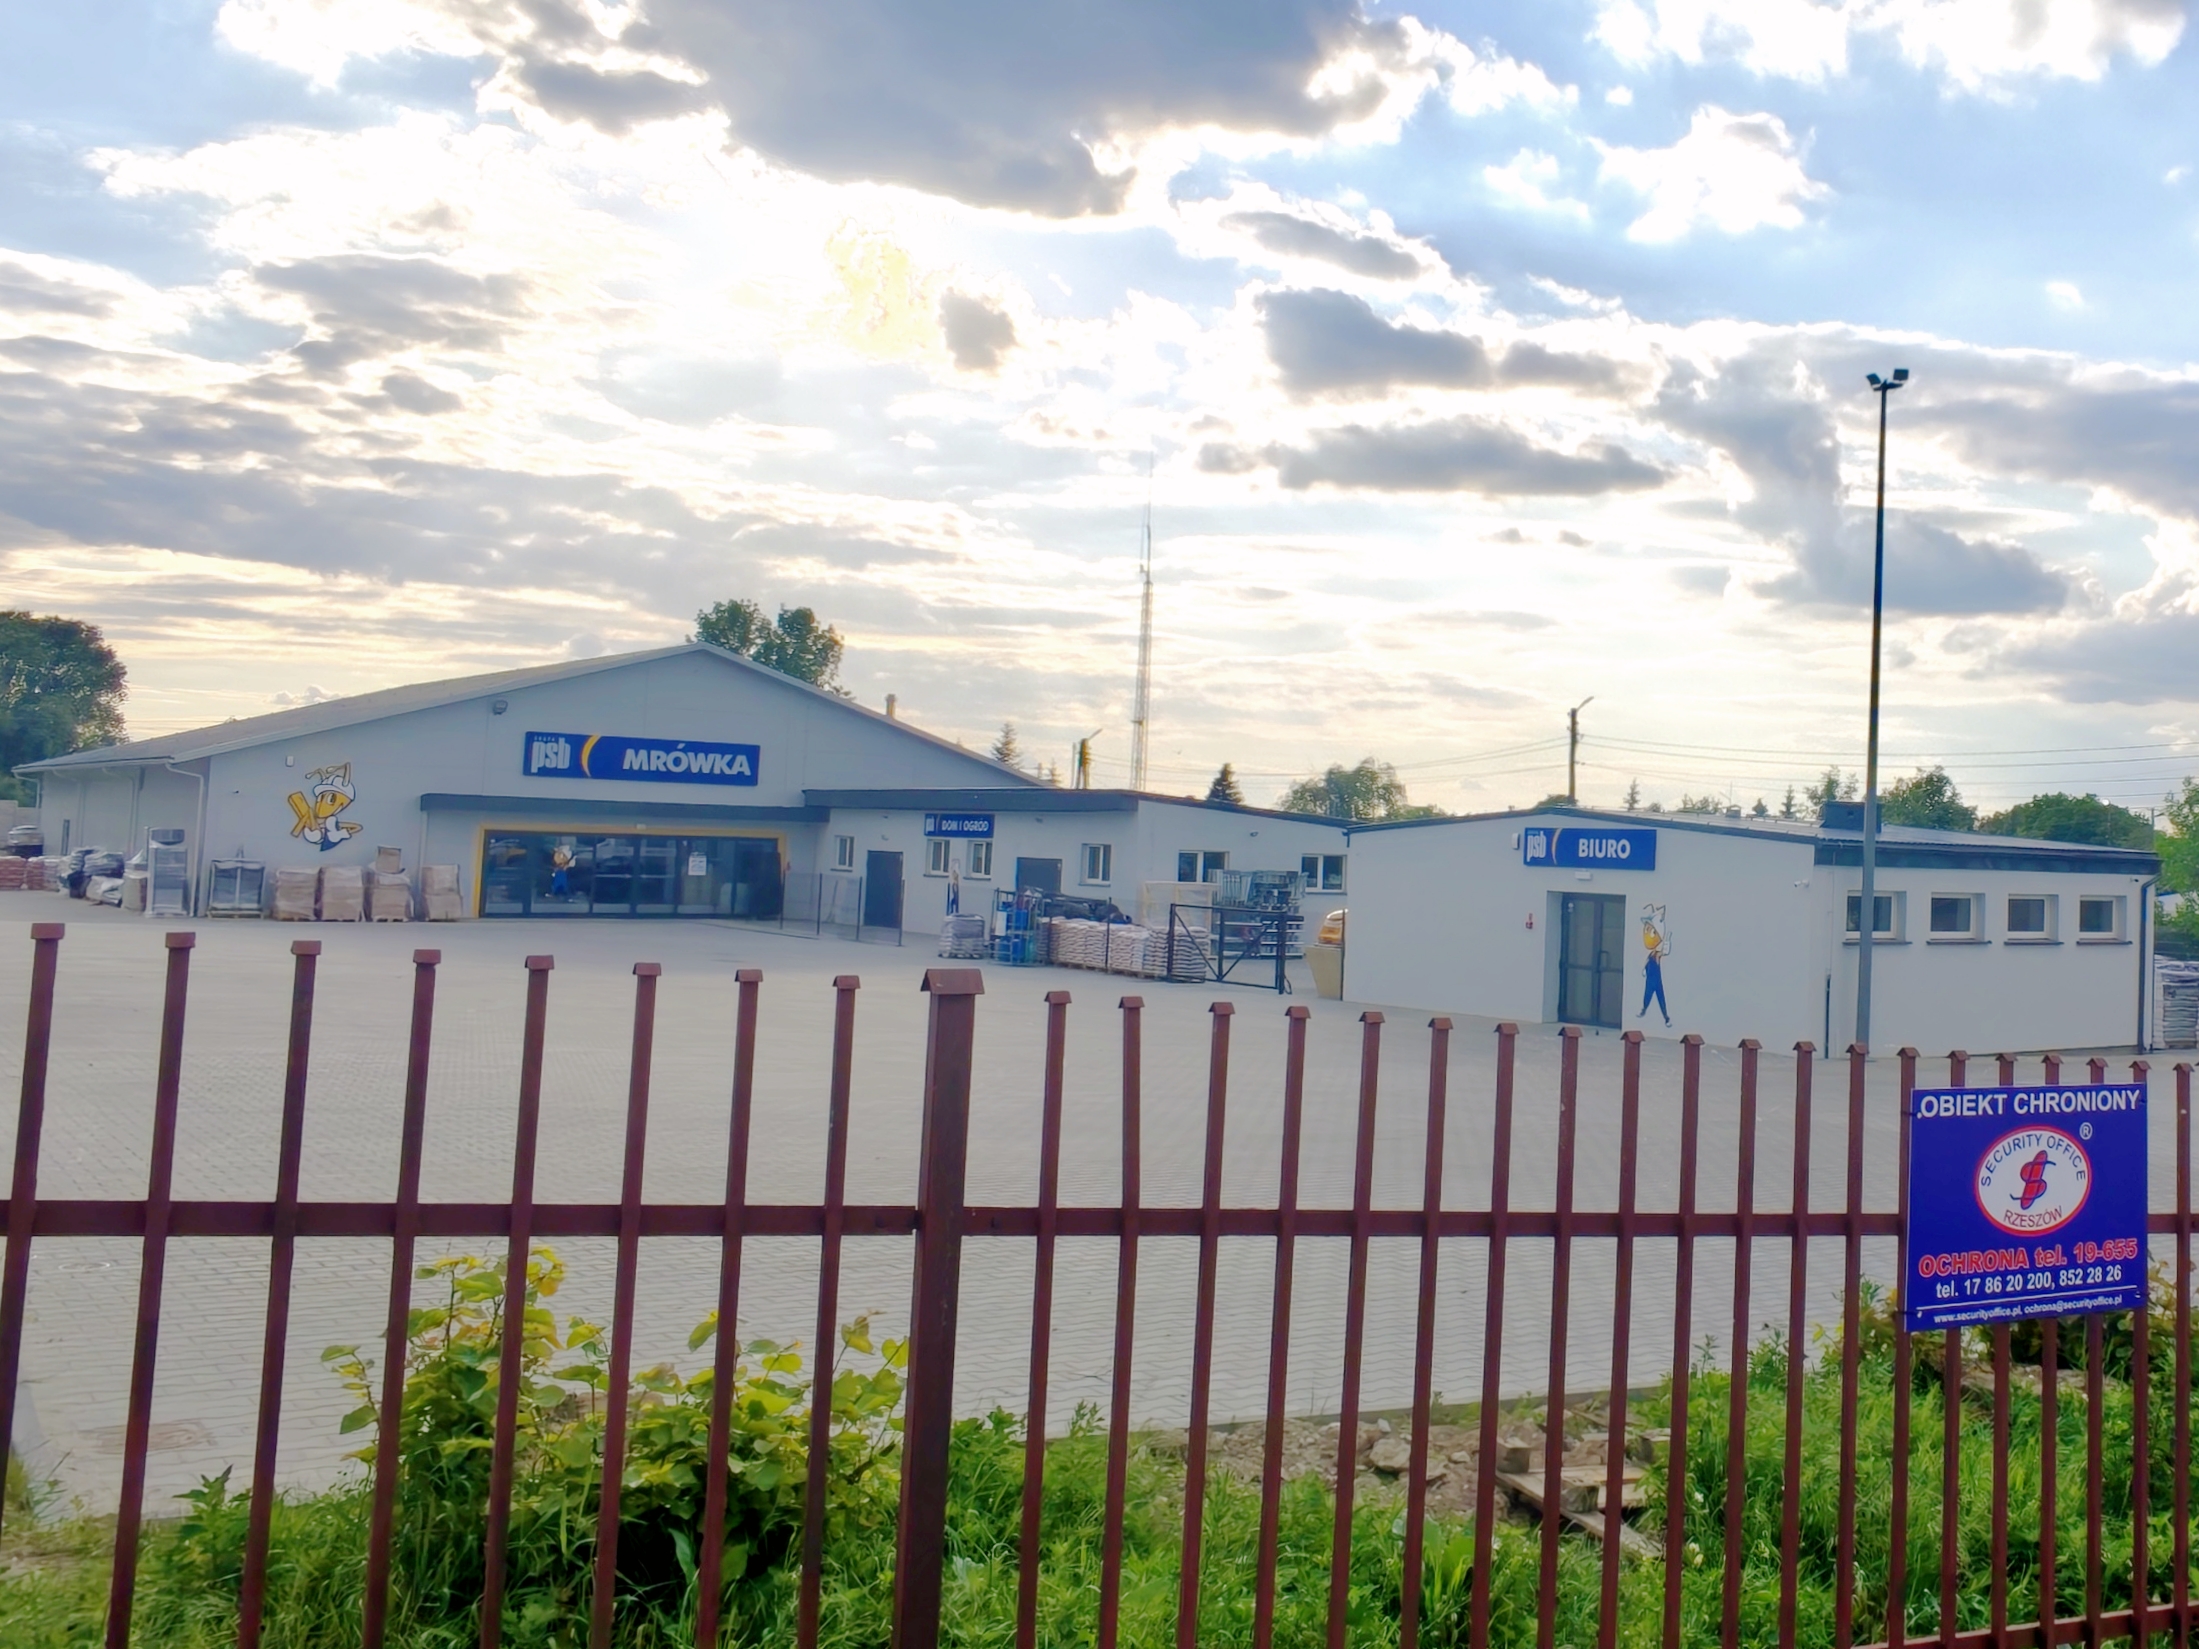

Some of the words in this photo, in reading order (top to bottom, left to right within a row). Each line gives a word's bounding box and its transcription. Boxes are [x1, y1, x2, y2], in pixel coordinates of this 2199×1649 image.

[531, 737, 571, 773] psb
[623, 743, 751, 776] MRÓWKA
[1527, 830, 1546, 862] psb
[1578, 838, 1631, 859] BIURO
[1920, 1094, 2008, 1117] OBIEKT
[2013, 1089, 2140, 1115] CHRONIONY
[1981, 1133, 2043, 1187] SECURITY
[2046, 1135, 2086, 1181] OFFICE
[2003, 1205, 2063, 1228] RZESZÓW
[1919, 1247, 2029, 1278] OCHRONA
[2034, 1244, 2067, 1268] tel.
[2073, 1238, 2138, 1263] 19-655
[1935, 1280, 1959, 1298] tel.
[1964, 1278, 1981, 1295] 17
[1984, 1275, 2002, 1293] 86
[2005, 1273, 2023, 1292] 20
[2026, 1271, 2055, 1290] 200,
[2059, 1268, 2083, 1286] 852
[2086, 1266, 2103, 1284] 28
[2105, 1264, 2122, 1282] 26
